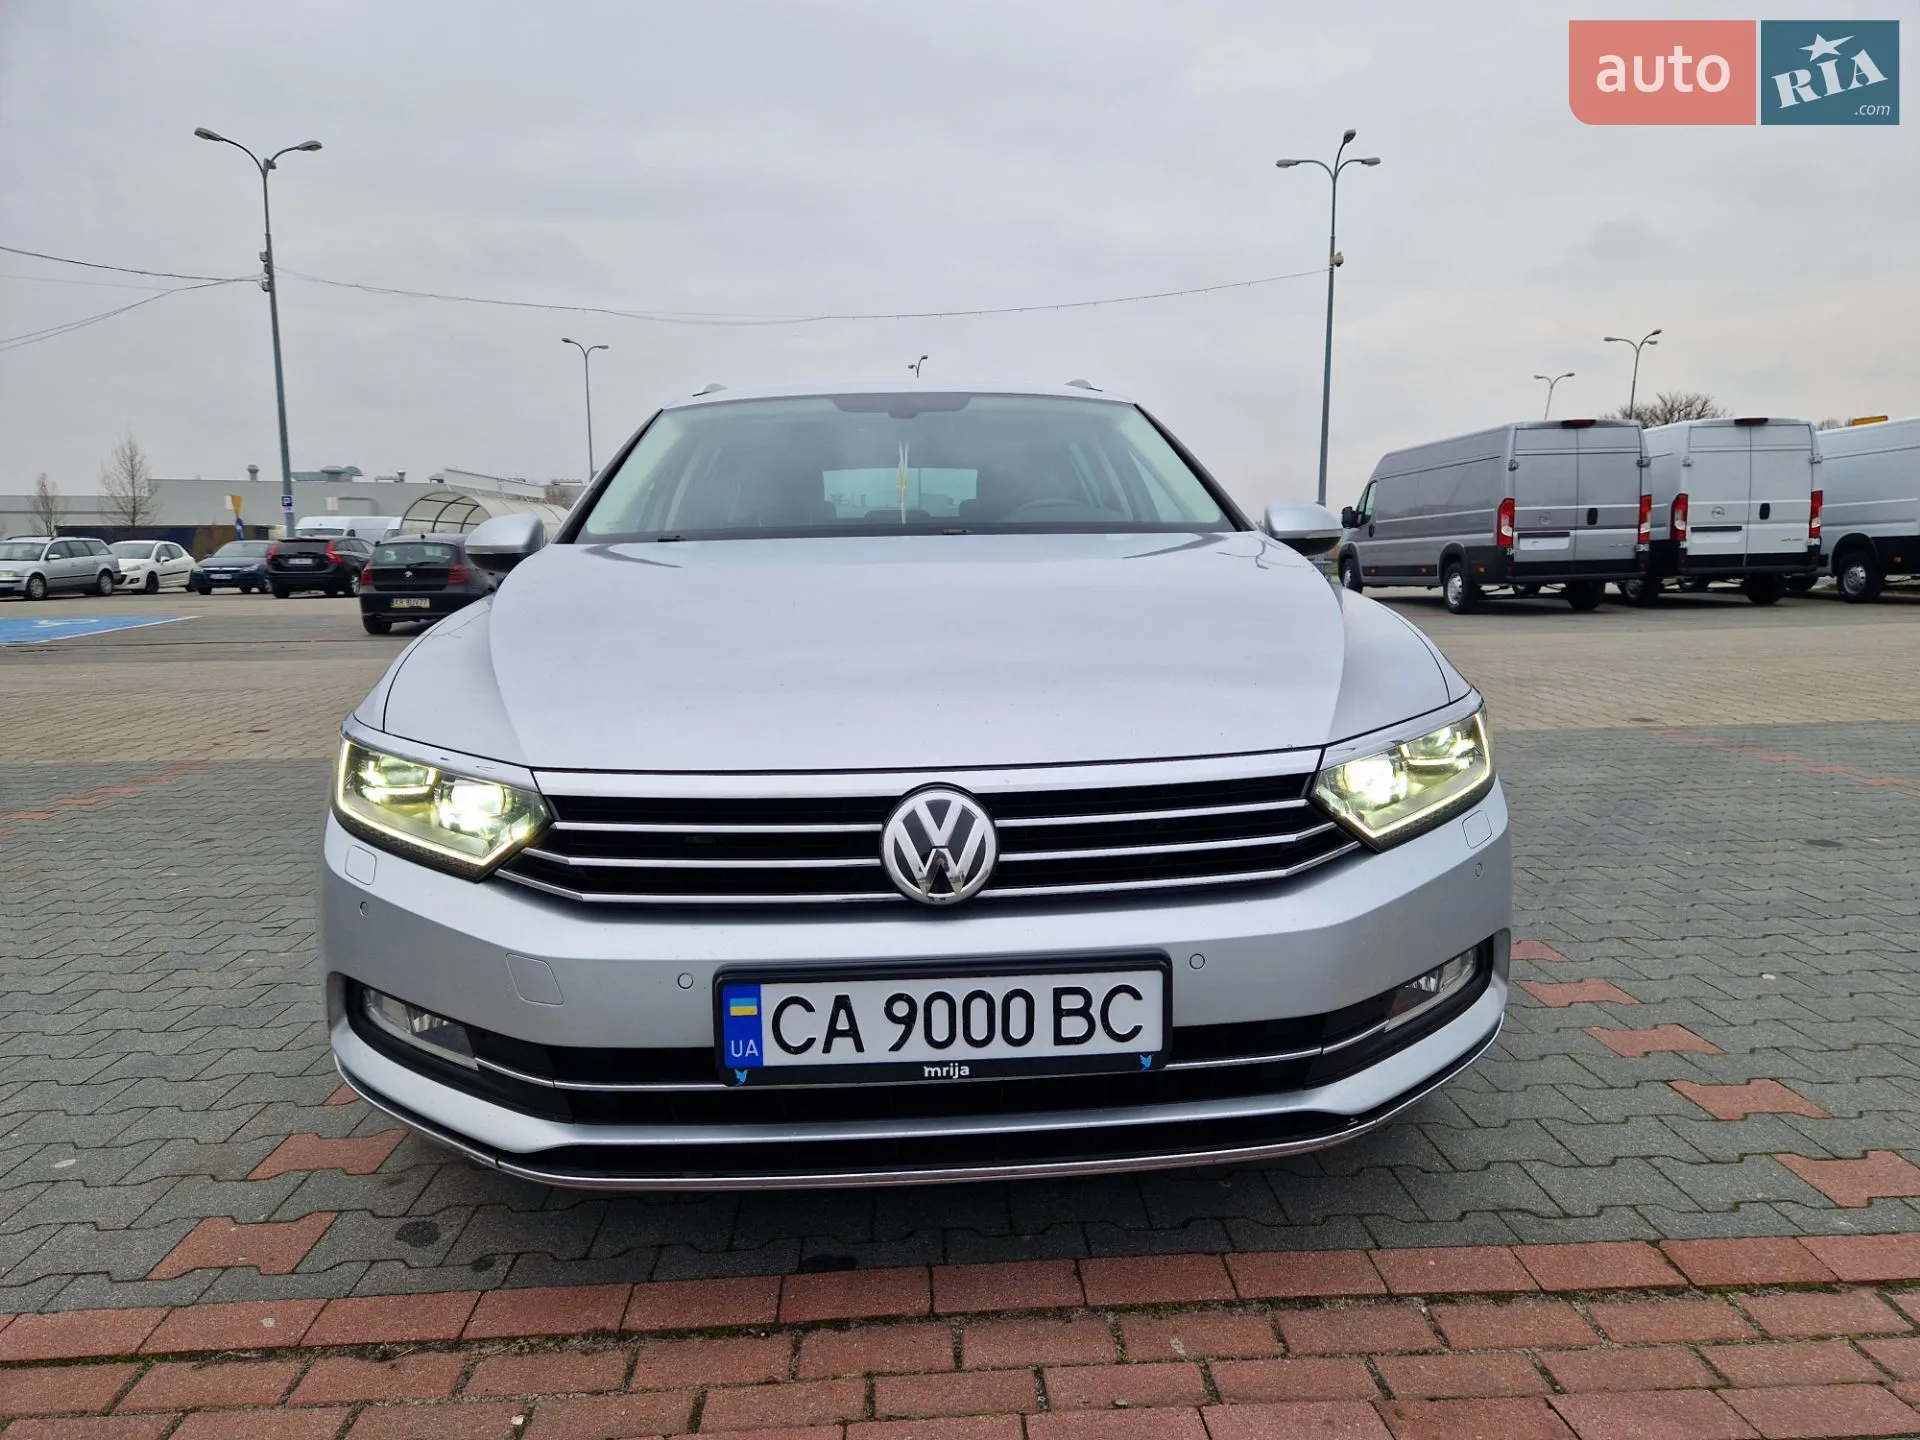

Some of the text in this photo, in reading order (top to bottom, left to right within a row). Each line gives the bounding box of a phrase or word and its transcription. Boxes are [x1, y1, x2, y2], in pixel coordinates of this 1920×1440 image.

[771, 984, 1144, 1056] CA 9000 BC
[730, 1039, 759, 1058] UA
[923, 1062, 970, 1079] mrija
